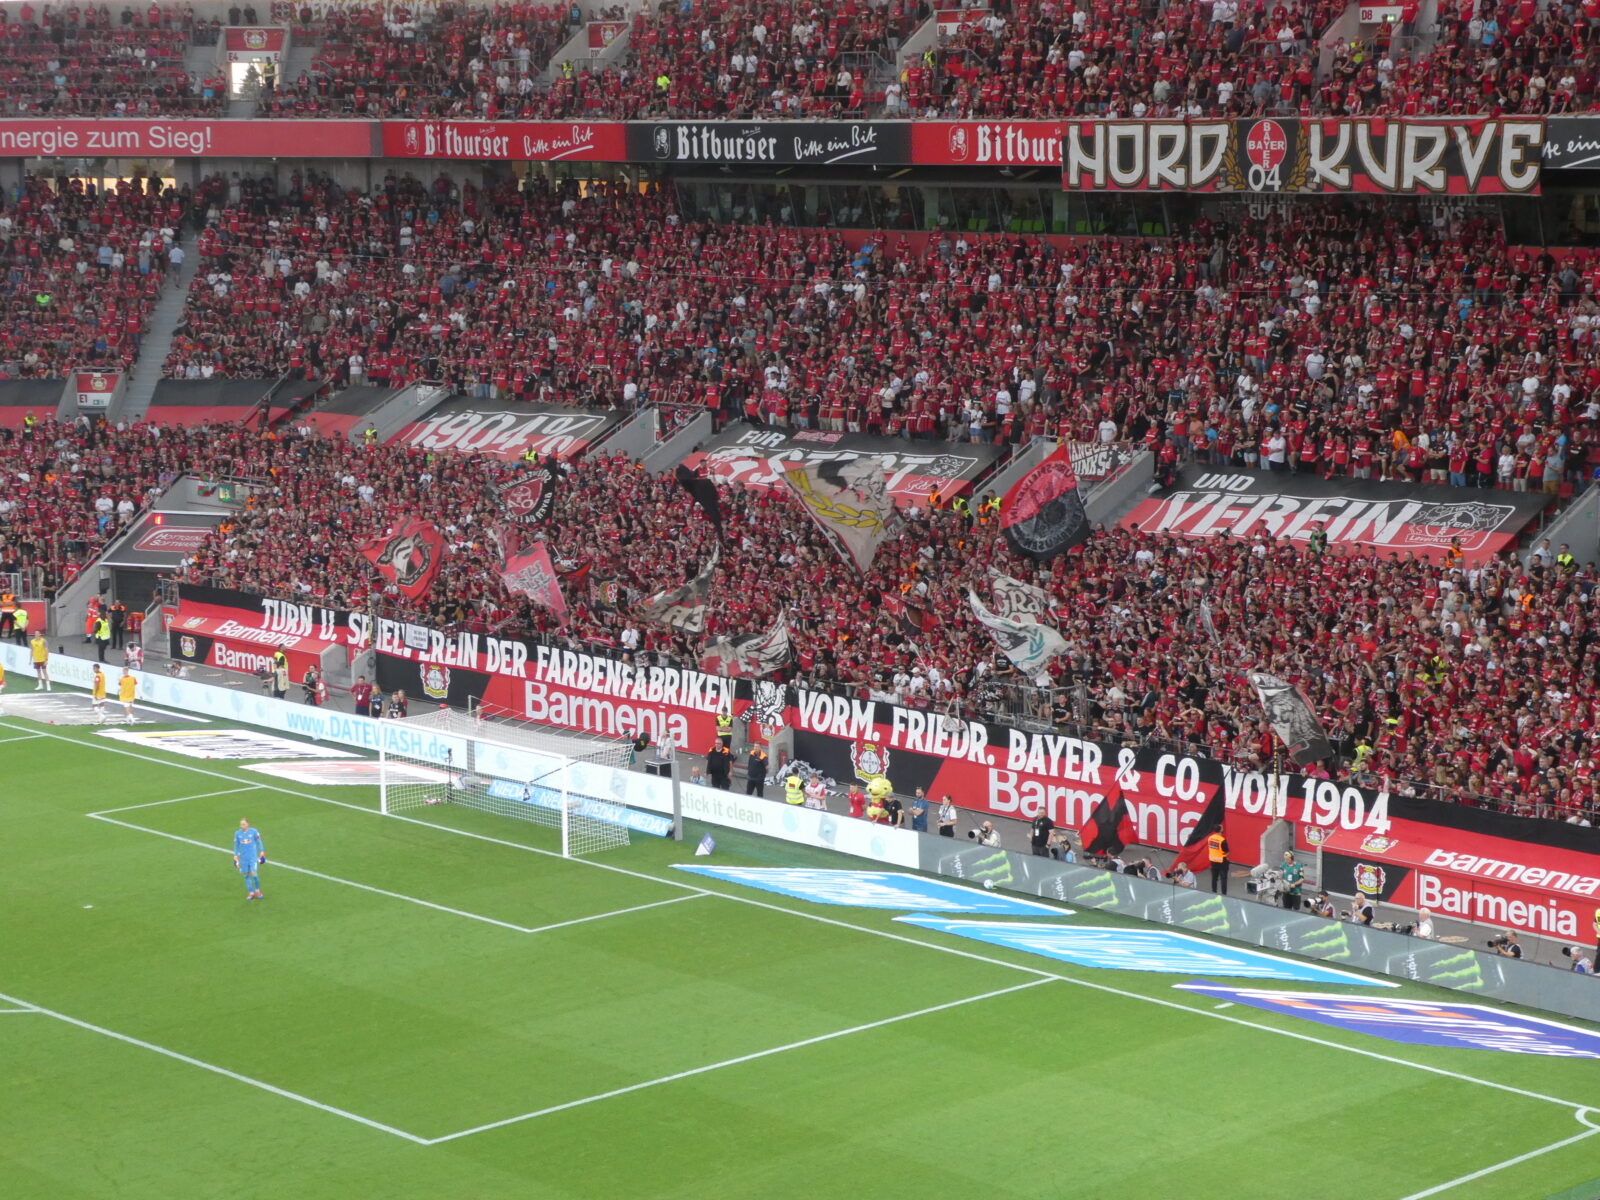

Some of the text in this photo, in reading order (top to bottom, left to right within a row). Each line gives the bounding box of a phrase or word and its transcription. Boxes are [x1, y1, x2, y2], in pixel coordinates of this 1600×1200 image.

[1, 125, 212, 154] nergie zum Sieg!
[424, 124, 509, 157] Bitburger
[676, 125, 777, 160] Bitburger
[794, 136, 824, 160] Bitte
[827, 137, 850, 151] ein
[976, 124, 1063, 162] Bitbur
[1067, 122, 1230, 188] NORD
[1308, 121, 1543, 192] KURVE
[1248, 163, 1282, 192] 04
[411, 412, 596, 454] 1904%
[736, 430, 787, 448] FÜR
[1193, 473, 1256, 492] UND
[1156, 493, 1423, 545] VEREIN
[1409, 535, 1467, 543] Leverkusn
[213, 619, 303, 648] Barmenia
[215, 642, 277, 673] Barmen
[261, 598, 313, 637] TURN
[319, 609, 338, 641] U.
[485, 637, 527, 678] DER
[535, 645, 736, 715] FARBENFABRIKEN
[798, 689, 880, 742] VORM.
[890, 707, 996, 767] FRIEDR.
[1007, 728, 1103, 785] BAYER
[1115, 747, 1141, 792] &
[1155, 754, 1206, 803] CO.
[1223, 764, 1289, 818] VON
[1300, 777, 1391, 835] 1904
[525, 680, 688, 749] Barmenia
[681, 791, 763, 825] click it clean
[1424, 848, 1600, 896] Barmenia
[1419, 874, 1578, 937] Barmenia
